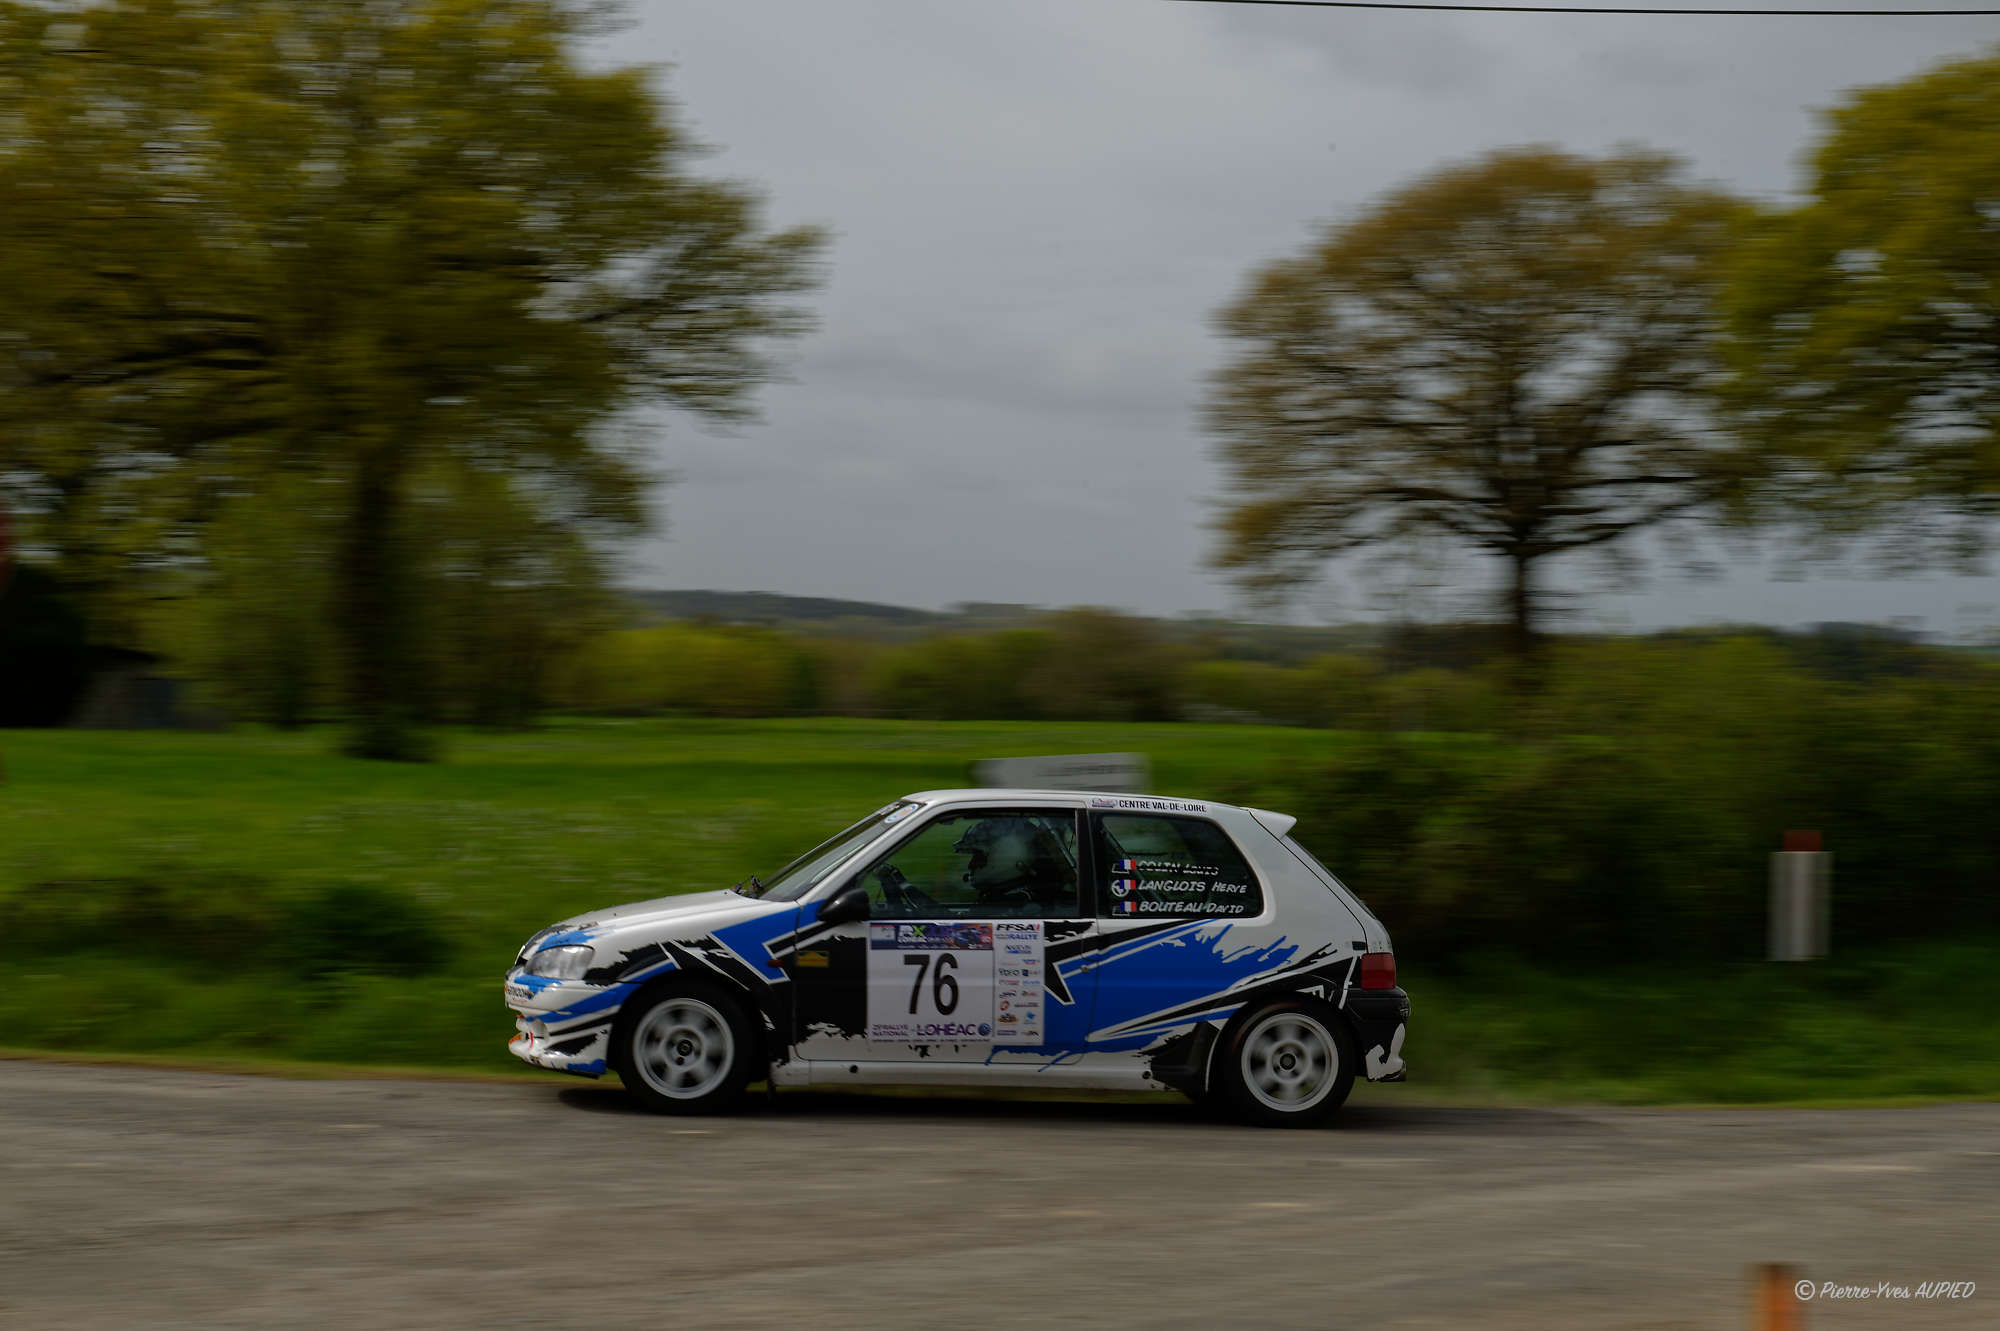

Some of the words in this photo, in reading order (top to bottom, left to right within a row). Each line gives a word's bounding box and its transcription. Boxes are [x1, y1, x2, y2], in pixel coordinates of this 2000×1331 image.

[1119, 799, 1150, 809] CENTRE
[1153, 801, 1207, 812] VAL-DE-LOIRE
[1137, 880, 1206, 892] LANGLOIS
[1211, 881, 1248, 894] HERVE
[1139, 901, 1202, 913] BOUTEAU
[903, 952, 959, 1016] 76
[916, 1021, 977, 1036] LOHÉAC
